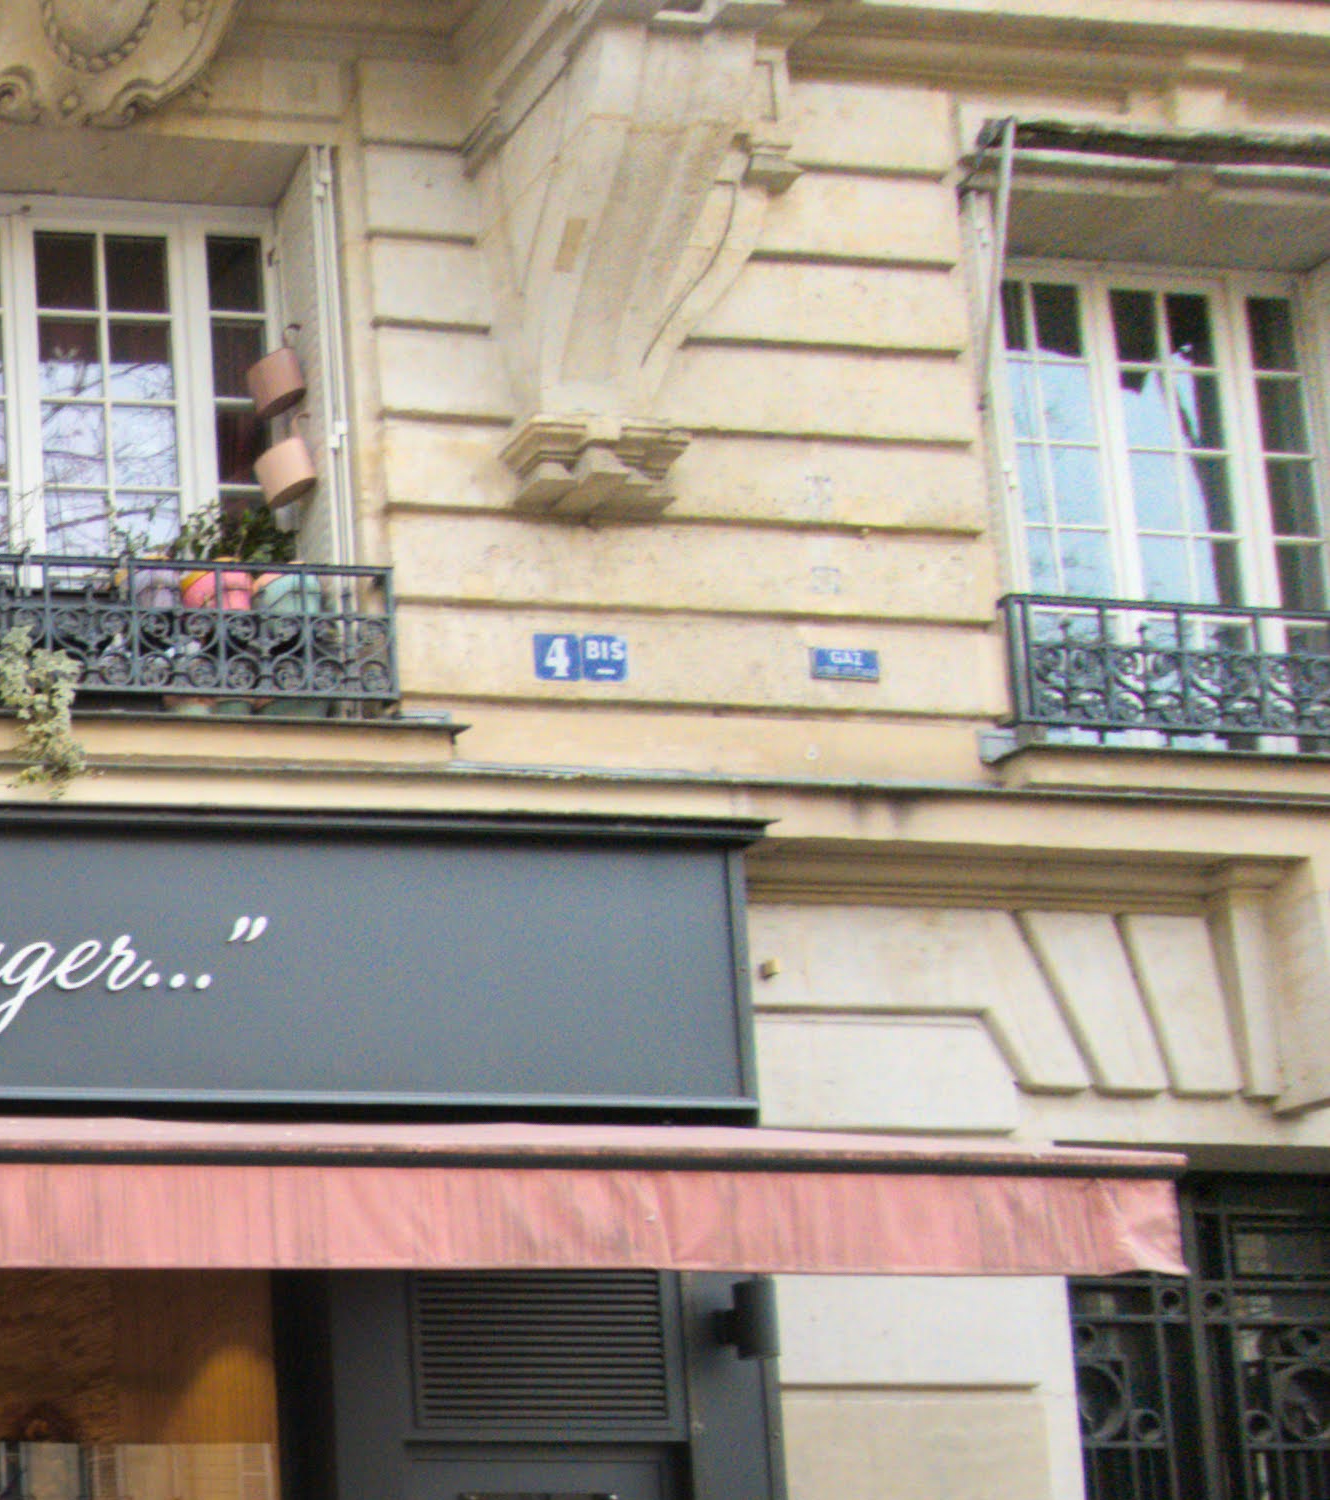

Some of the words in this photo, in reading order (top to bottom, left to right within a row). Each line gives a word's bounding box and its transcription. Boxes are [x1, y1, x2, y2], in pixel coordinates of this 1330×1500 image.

[544, 637, 570, 678] 4
[585, 639, 626, 661] BIS
[830, 651, 864, 666] GAZ
